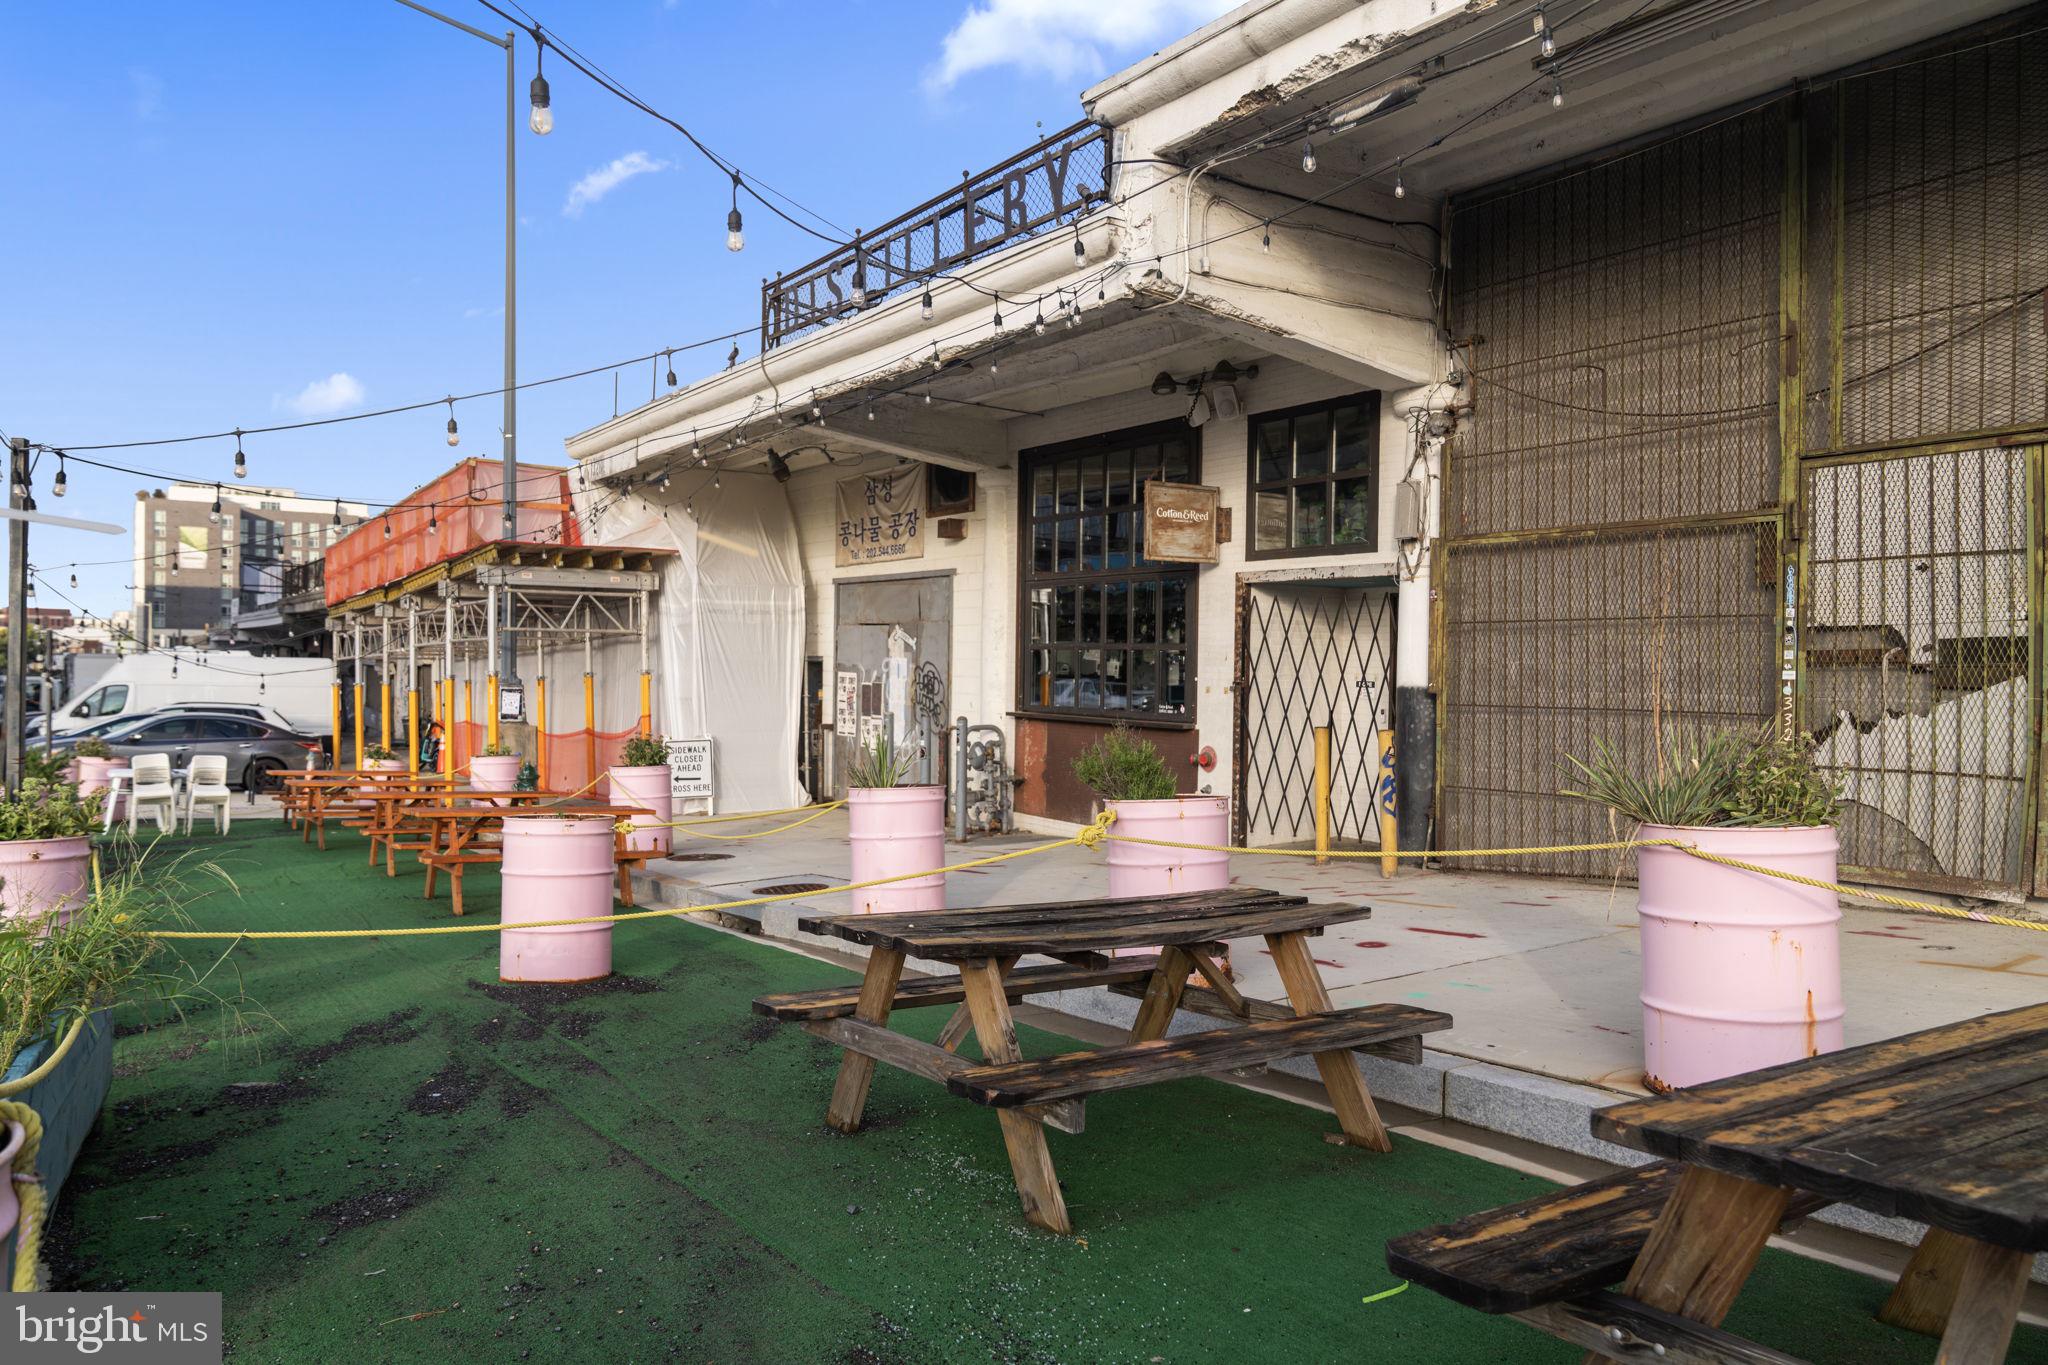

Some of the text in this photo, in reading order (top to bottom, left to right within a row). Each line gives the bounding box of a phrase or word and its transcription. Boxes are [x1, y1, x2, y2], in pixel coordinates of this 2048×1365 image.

[865, 475, 893, 505] 삼성
[839, 508, 920, 547] 콩나물 공장
[674, 755, 704, 763] CLOSED
[677, 764, 702, 772] AHEAD
[672, 783, 711, 793] ROSS HERE
